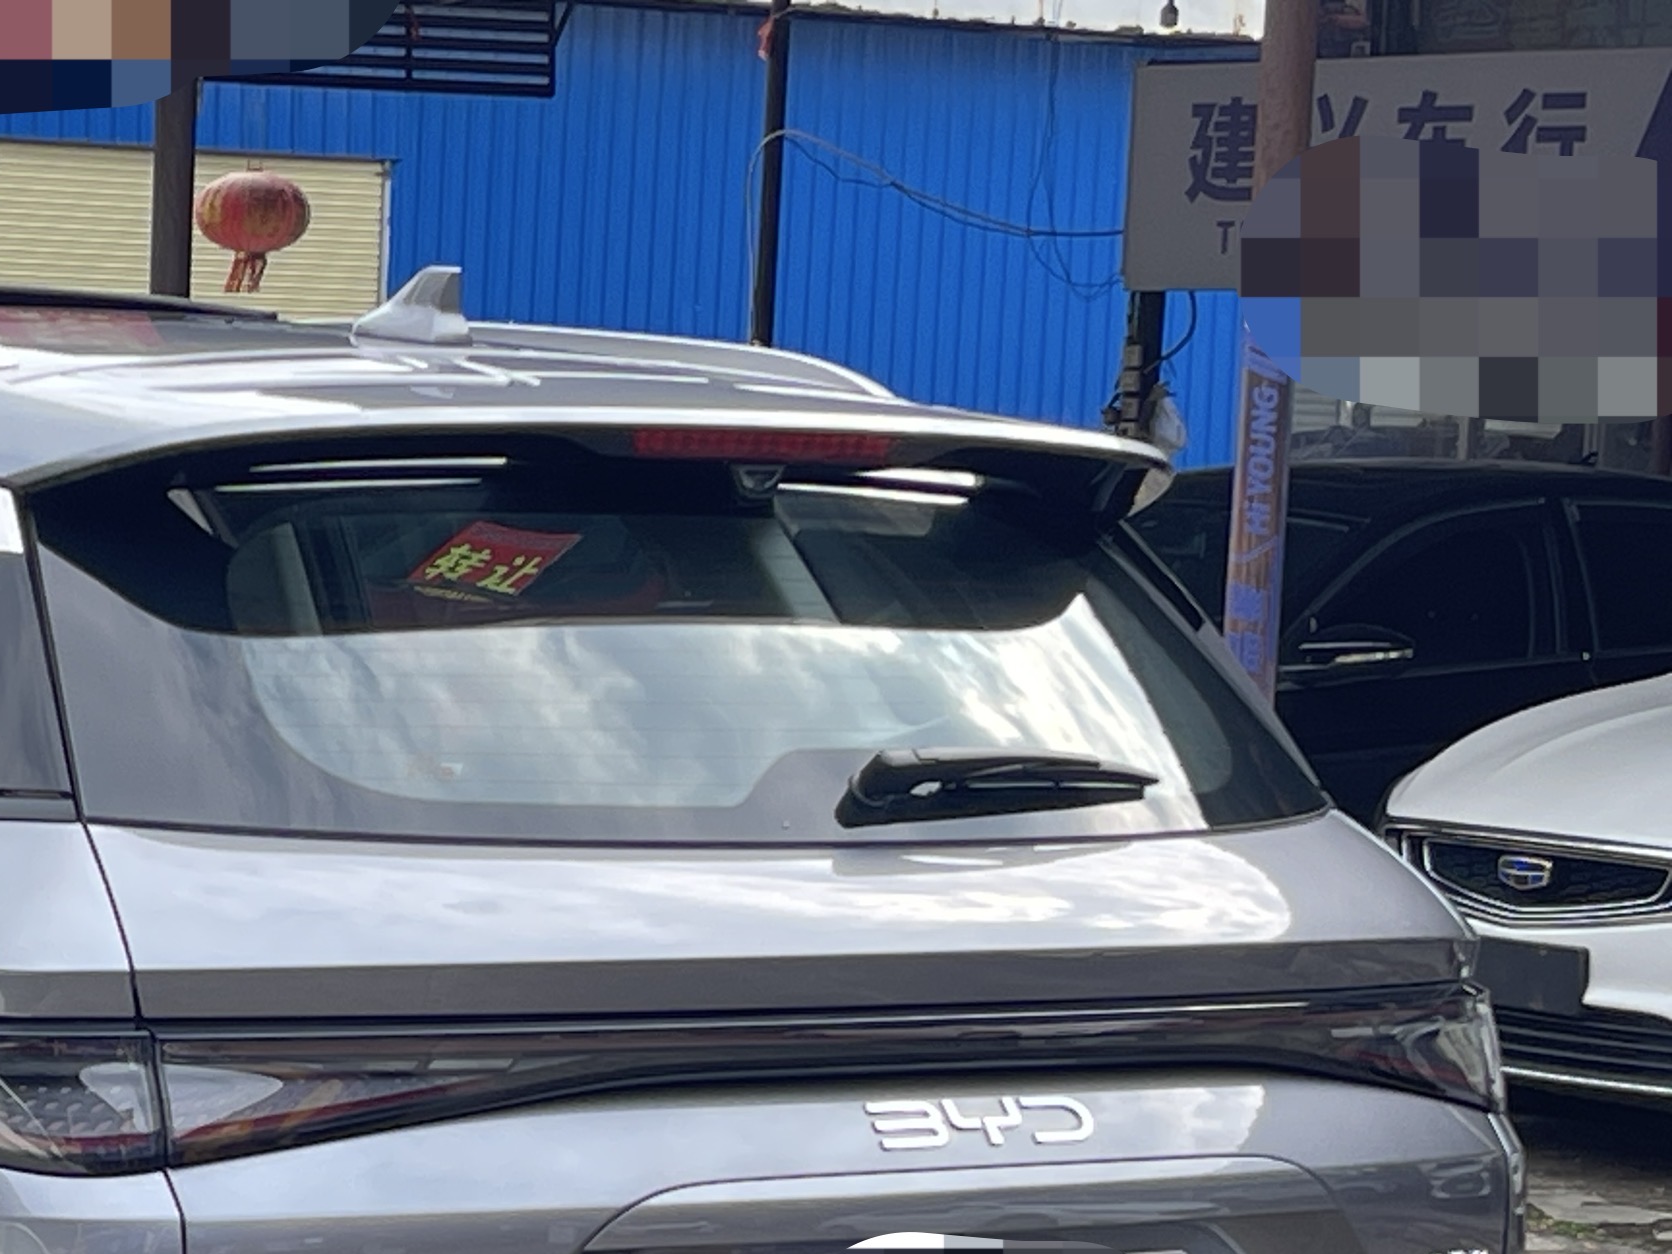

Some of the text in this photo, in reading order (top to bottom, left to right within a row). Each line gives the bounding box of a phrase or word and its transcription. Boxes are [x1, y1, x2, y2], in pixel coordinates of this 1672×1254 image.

[1245, 380, 1278, 497] YOUNG
[425, 543, 542, 595] 转让
[863, 1096, 1095, 1151] BYD
